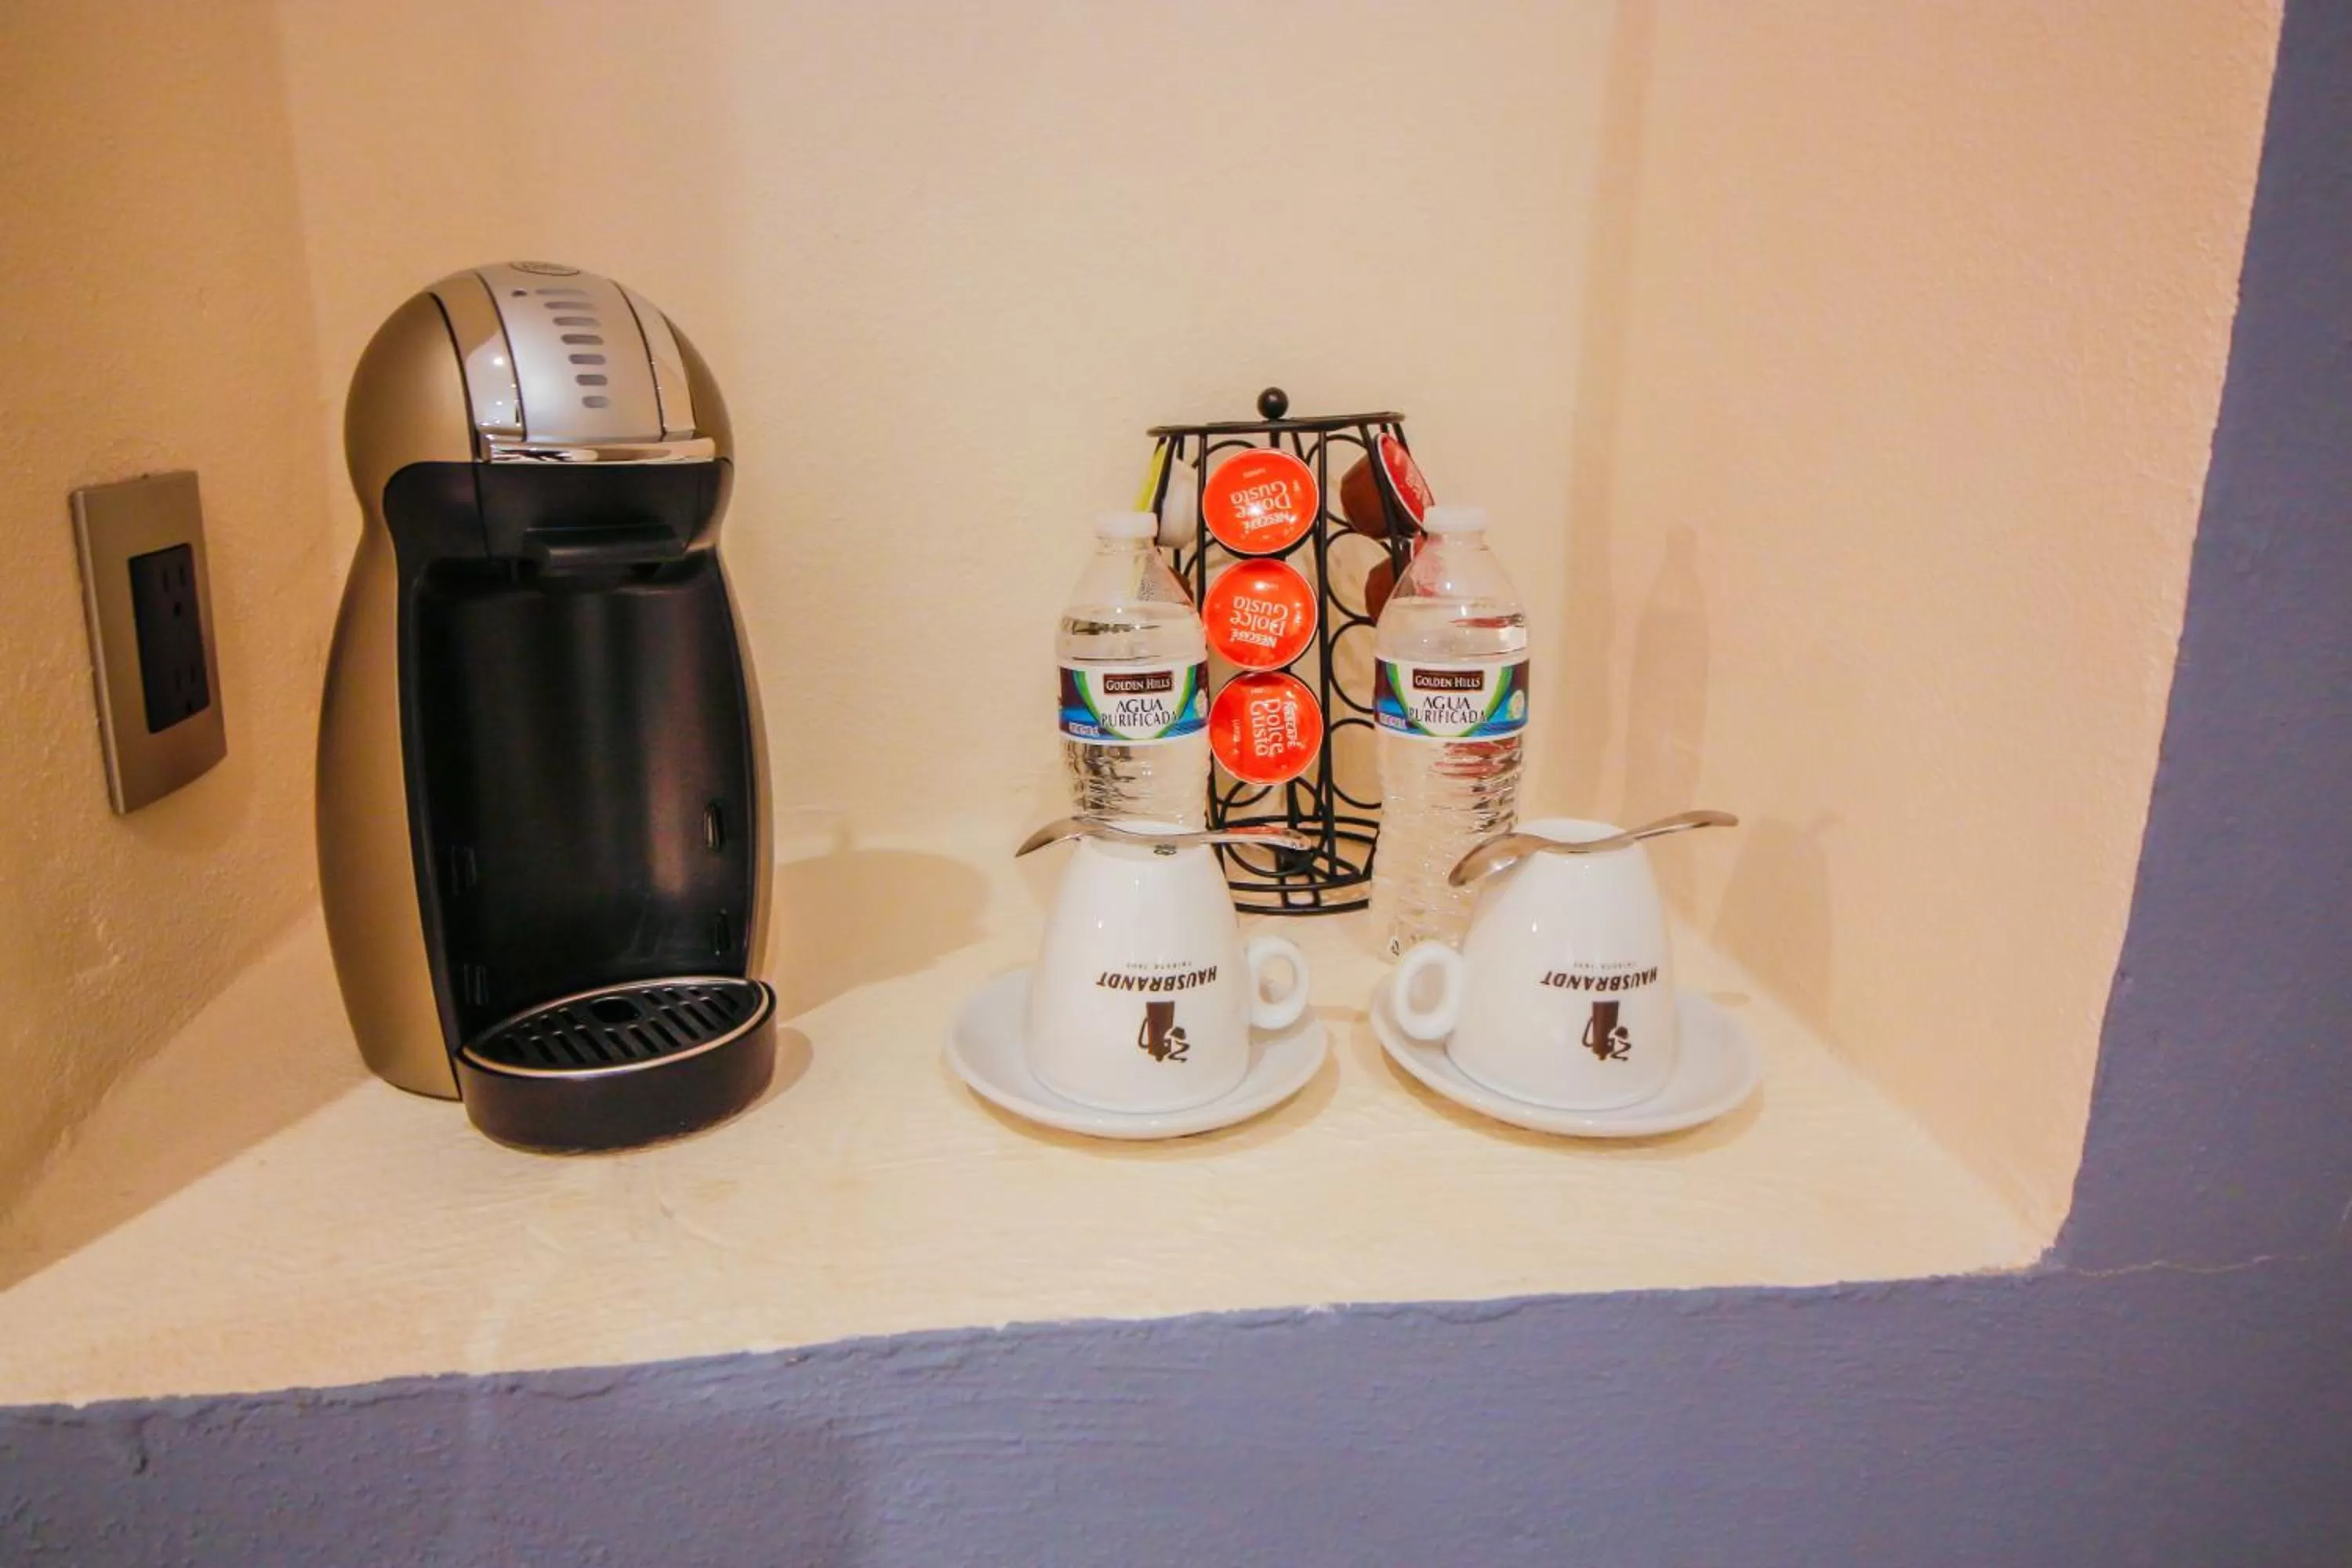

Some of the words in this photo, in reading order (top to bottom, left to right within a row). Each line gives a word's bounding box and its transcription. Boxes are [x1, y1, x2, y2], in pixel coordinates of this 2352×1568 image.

[1229, 480, 1287, 505] Gusto
[1232, 596, 1288, 621] Gusto
[1229, 610, 1287, 637] Dolce
[1116, 699, 1163, 713] AGUA
[1424, 695, 1471, 710] AGUA
[1250, 700, 1269, 757] Gusto
[1266, 699, 1284, 757] Dolce
[1095, 965, 1218, 992] HAUSBRANDT
[1540, 966, 1658, 992] HAUSBRANDT
